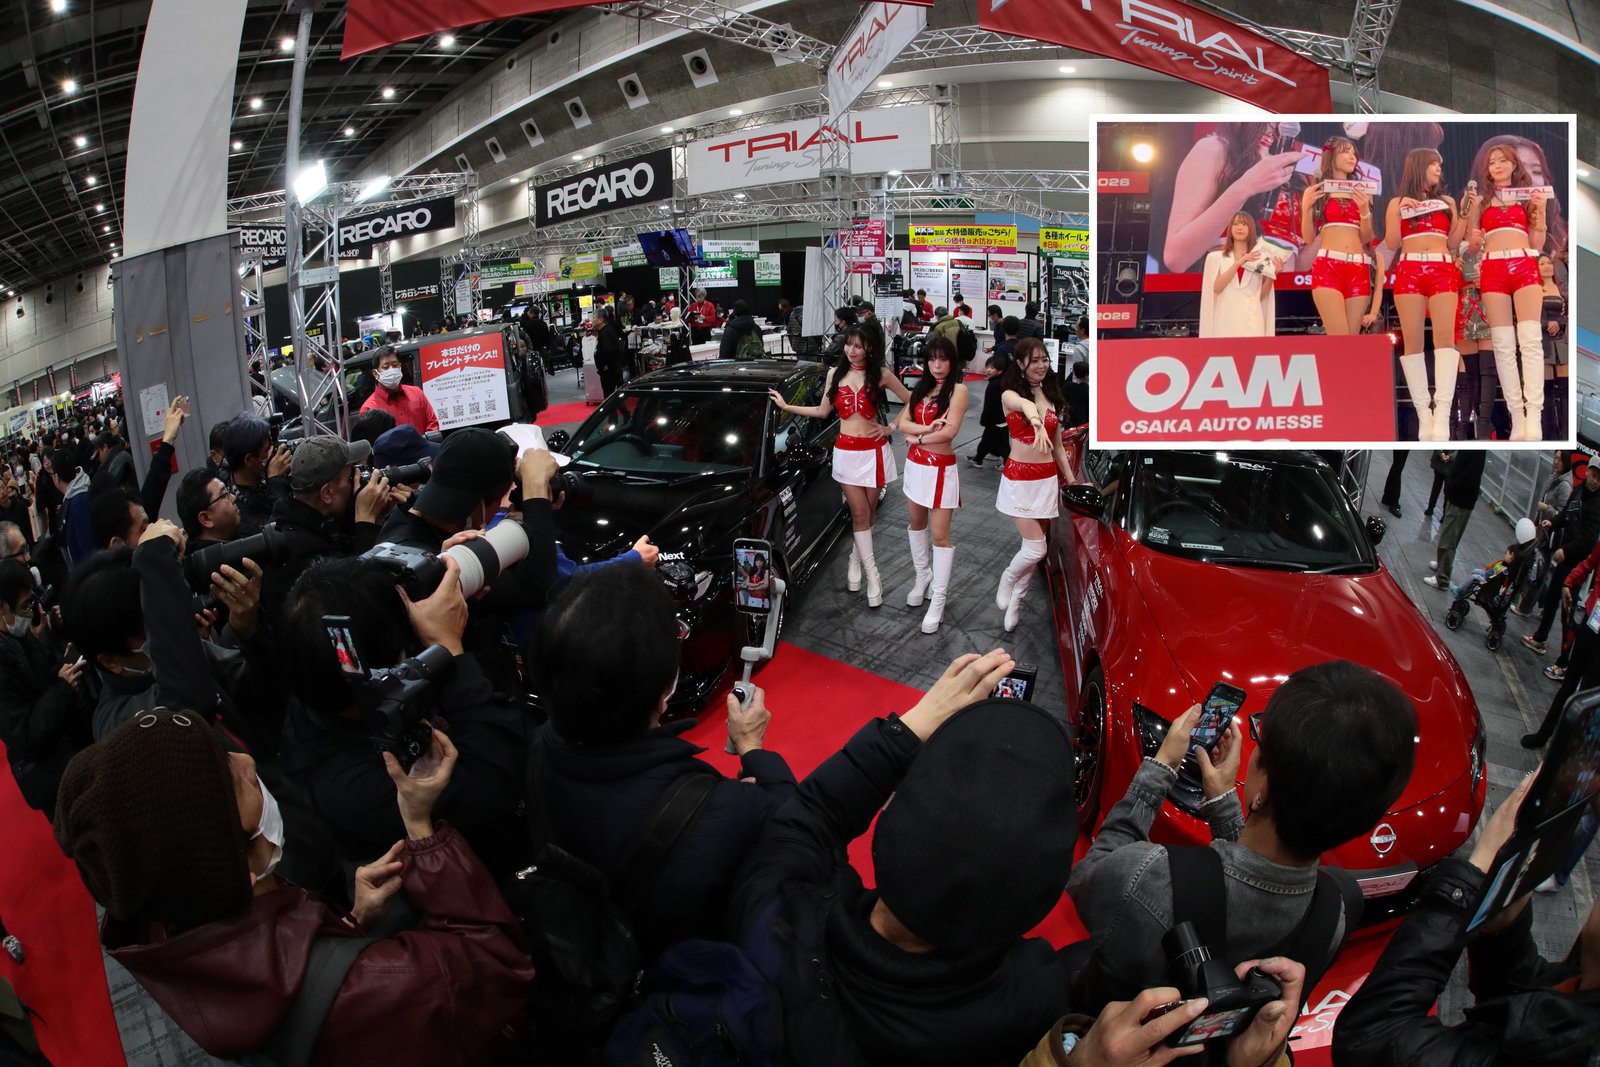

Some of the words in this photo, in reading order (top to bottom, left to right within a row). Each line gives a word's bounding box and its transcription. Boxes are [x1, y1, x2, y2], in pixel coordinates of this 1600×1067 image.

[1081, 0, 1297, 87] RIAL
[1114, 23, 1194, 61] Tuning
[1193, 50, 1259, 85] Spirit
[707, 121, 898, 162] TRIAL
[743, 156, 795, 177] Tuning
[547, 162, 654, 218] RECARO
[241, 229, 286, 246] RECARO
[340, 207, 432, 246] RECARO
[915, 227, 934, 236] HKS
[440, 343, 481, 358] 本日だけの
[1126, 354, 1324, 413] OAM
[1120, 417, 1192, 435] OSAKA
[1197, 416, 1252, 432] AUTO
[1255, 415, 1323, 430] MESSE
[658, 552, 685, 561] Next
